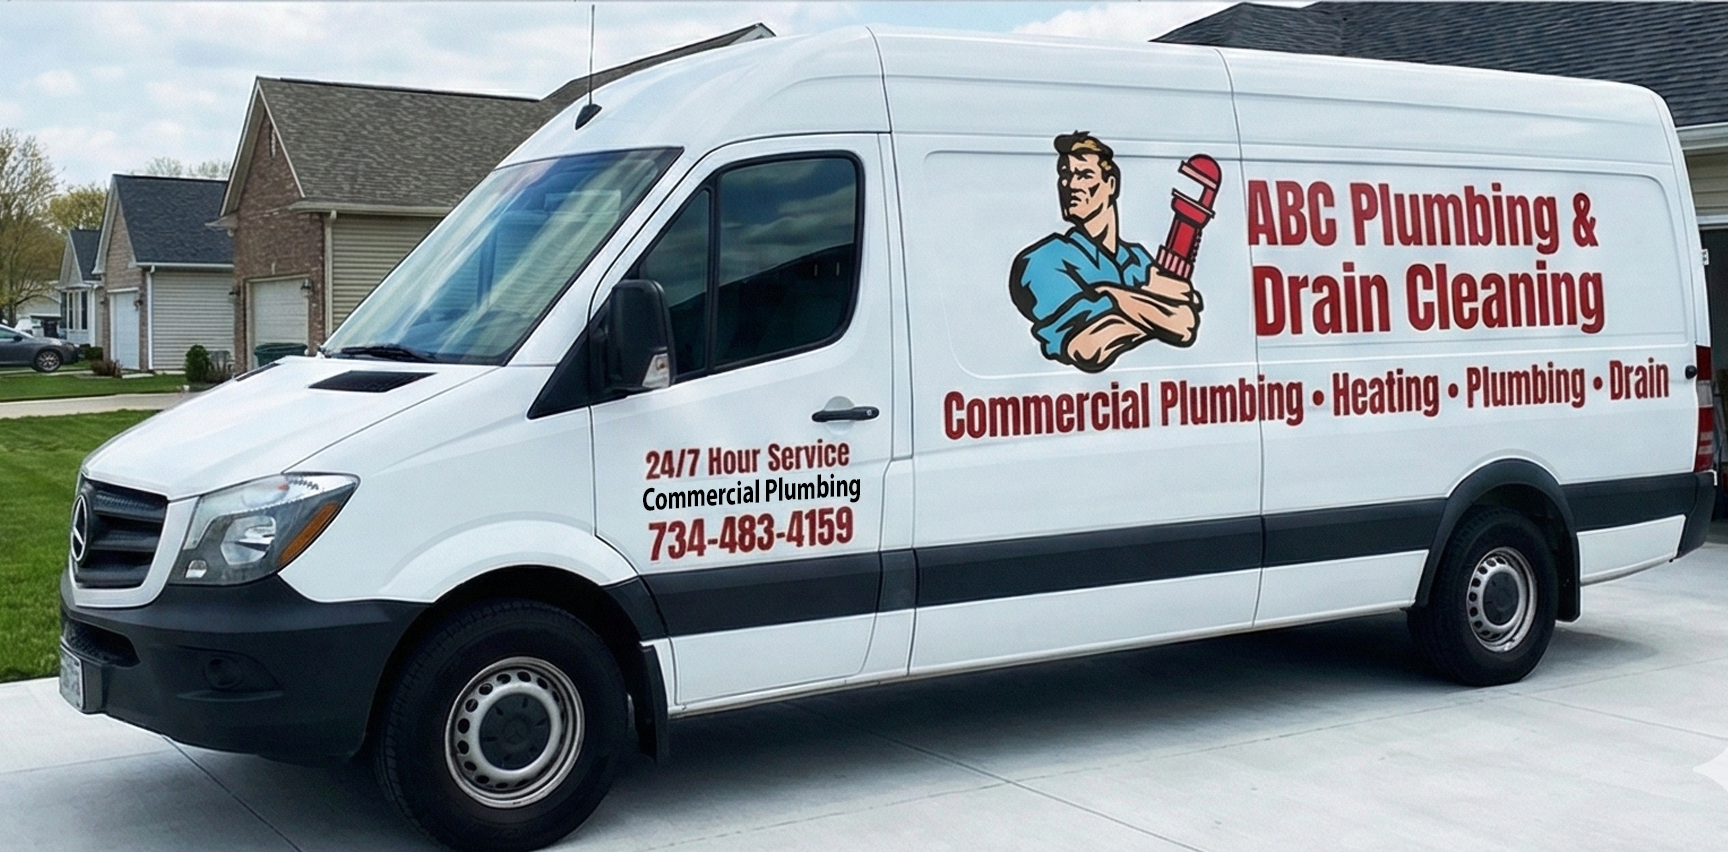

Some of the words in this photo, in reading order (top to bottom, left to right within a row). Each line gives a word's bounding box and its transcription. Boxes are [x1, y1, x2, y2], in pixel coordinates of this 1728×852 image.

[1248, 180, 1337, 246] ABC
[1351, 182, 1558, 255] Plumbing
[1571, 192, 1599, 247] &
[1252, 262, 1391, 336] Drain
[1405, 259, 1604, 333] Cleaning
[944, 382, 1150, 440] Commercial
[1160, 375, 1304, 426] Plumbing
[1332, 369, 1439, 417] Heating
[1466, 362, 1586, 408] Plumbing
[1609, 357, 1670, 401] Drain
[643, 480, 759, 511] Commercial
[766, 473, 861, 502] Plumbing
[646, 448, 700, 480] 24/7
[708, 447, 760, 475] Hour
[768, 439, 849, 472] Service
[649, 506, 853, 561] 734-483-4159
